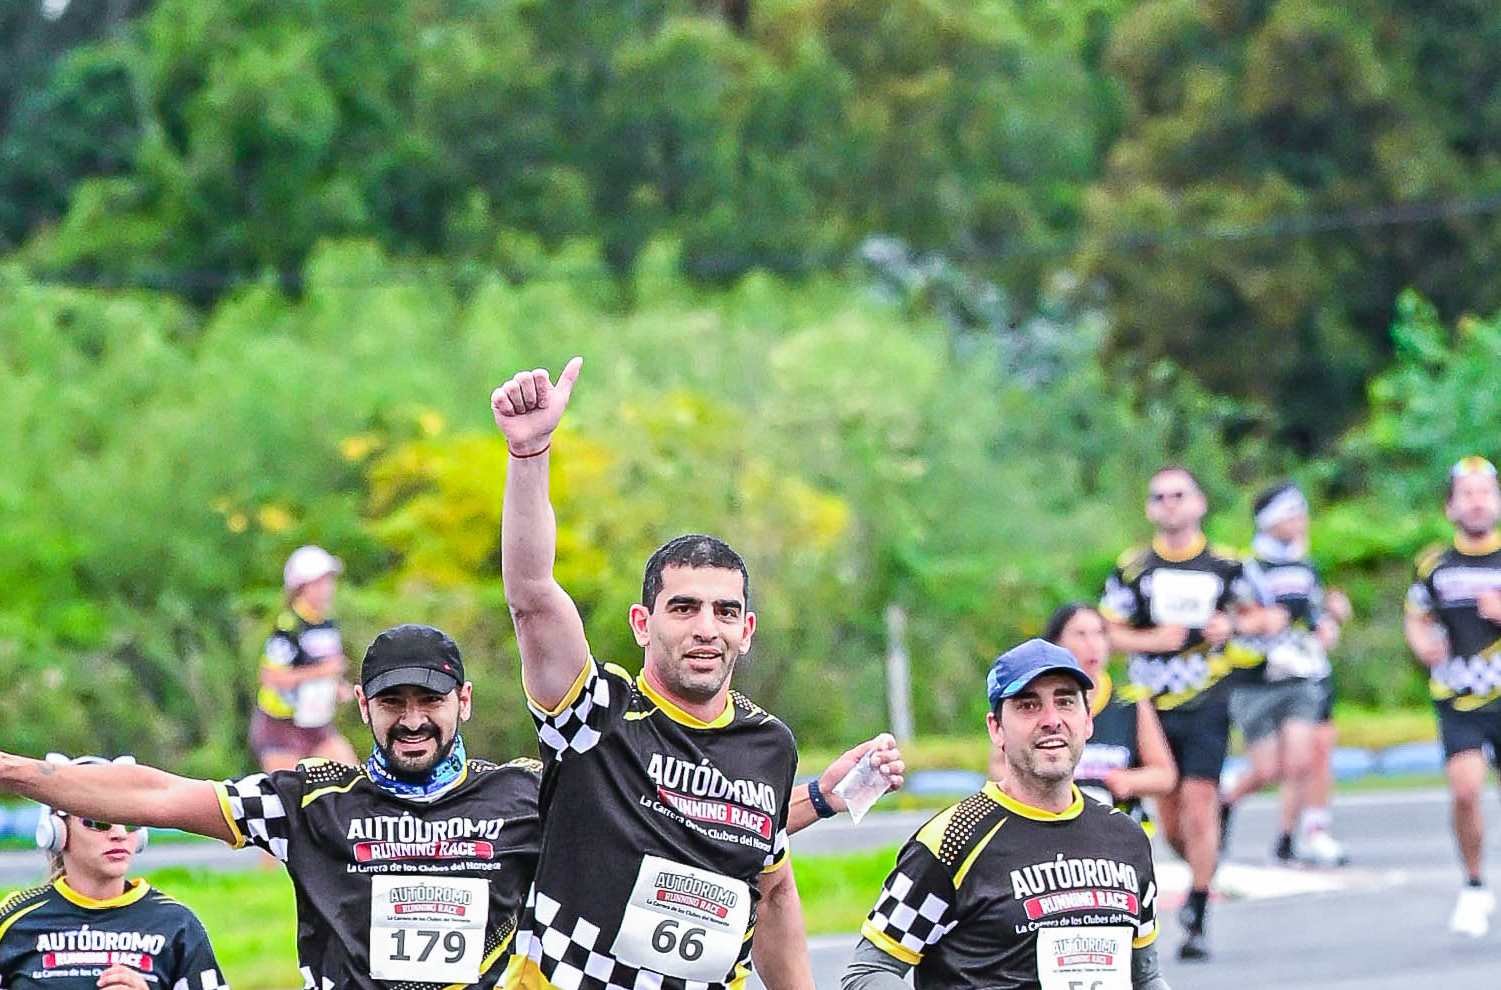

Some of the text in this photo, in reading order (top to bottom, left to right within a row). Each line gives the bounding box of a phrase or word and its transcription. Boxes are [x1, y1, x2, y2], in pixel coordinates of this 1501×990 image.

[647, 752, 776, 816] AUTÓDROMO
[346, 810, 505, 843] AUTÓDROMO
[639, 795, 652, 807] La
[652, 801, 684, 824] Carrera
[708, 829, 739, 843] Clubes
[739, 834, 753, 847] del
[729, 806, 765, 833] RACE
[370, 841, 477, 859] RUNNING RACE
[347, 863, 357, 873] La
[389, 862, 402, 872] de
[1009, 853, 1139, 900] AUTÓDROMO
[389, 882, 473, 906] AUTÓDROMO
[654, 872, 738, 909] AUTÓDROMO
[1039, 891, 1129, 915] RUNNING RACE
[36, 924, 166, 955] AUTÓDROMO
[651, 919, 707, 962] 66
[1015, 924, 1027, 934] La
[389, 929, 466, 964] 179
